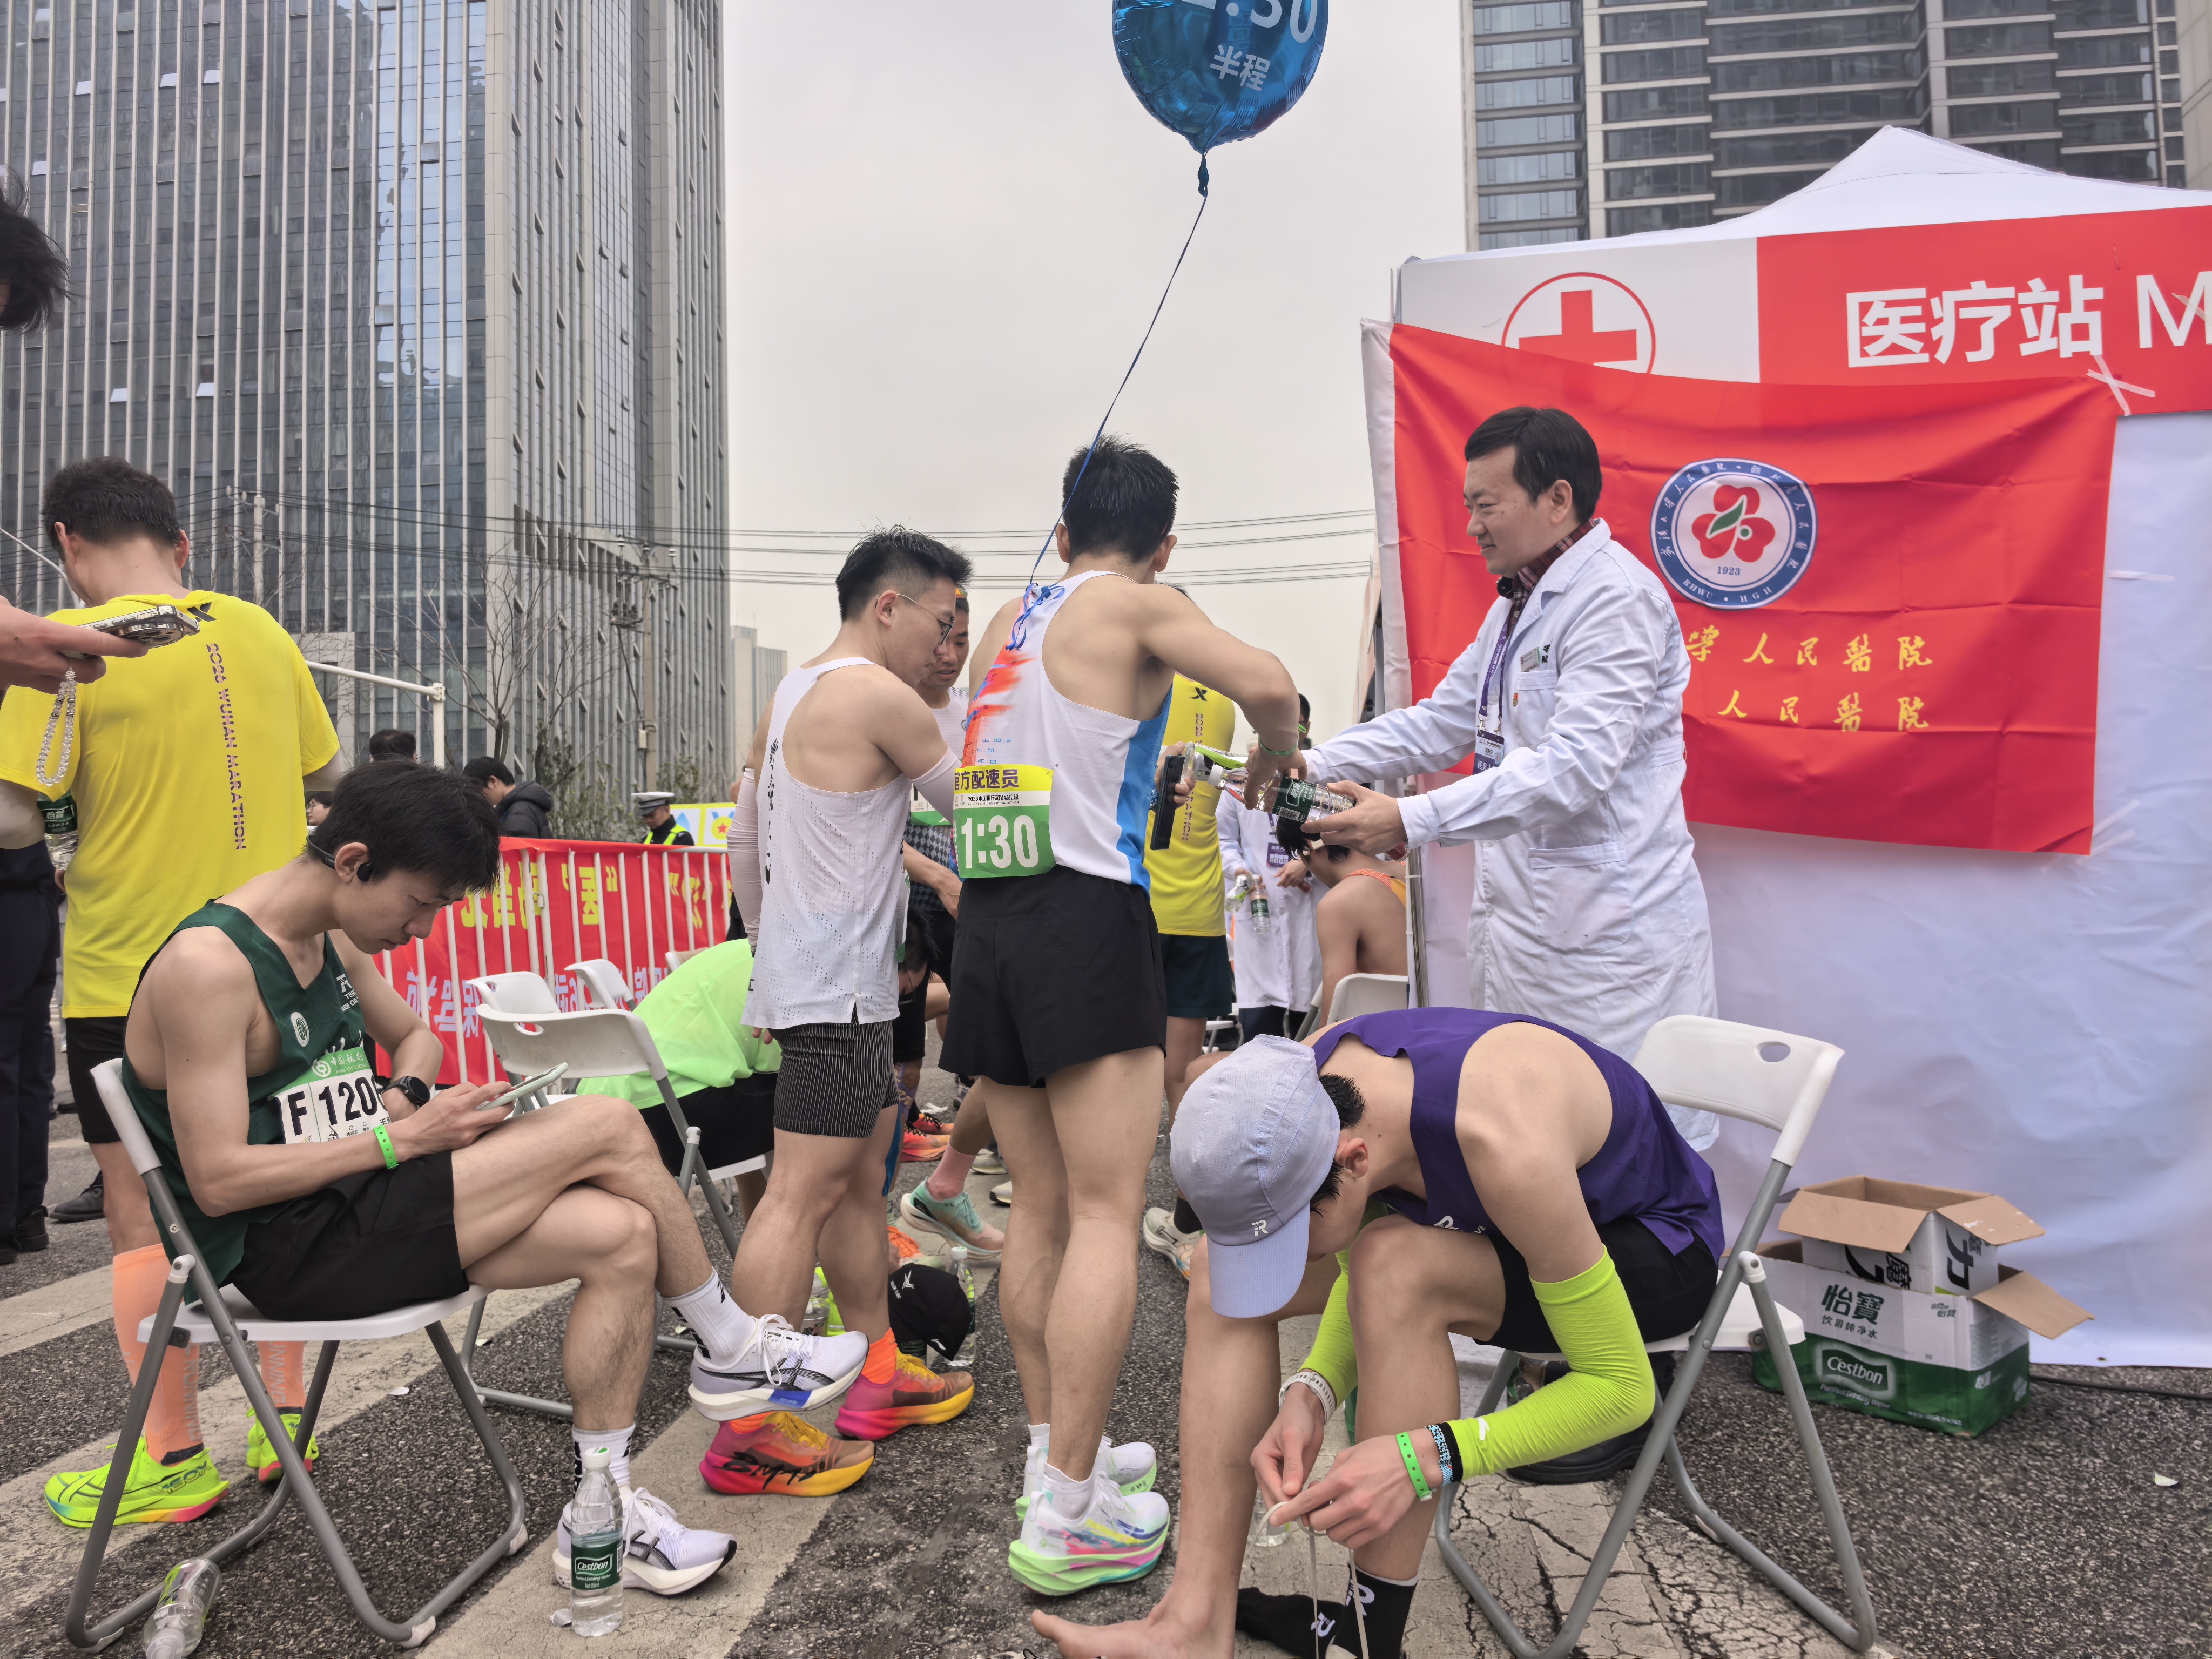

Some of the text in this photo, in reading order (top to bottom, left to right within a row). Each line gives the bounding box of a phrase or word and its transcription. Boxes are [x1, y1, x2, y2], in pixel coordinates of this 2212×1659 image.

[1210, 45, 1270, 91] 半程
[1846, 275, 2105, 368] 医疗站
[1683, 578, 1714, 599] RHWU
[1717, 565, 1741, 576] 1923
[1195, 712, 1203, 737] 2026
[206, 643, 246, 851] 2026 WUHAN MARATHON
[955, 768, 1019, 791] 官方配速员
[961, 815, 1039, 868] 1:30
[331, 1051, 365, 1067] 中國銀行
[287, 1075, 385, 1136] F 120
[1821, 1284, 1884, 1325] 怡寶
[1822, 1314, 1878, 1339] 饮用纯净水
[268, 1341, 287, 1405] UNNING
